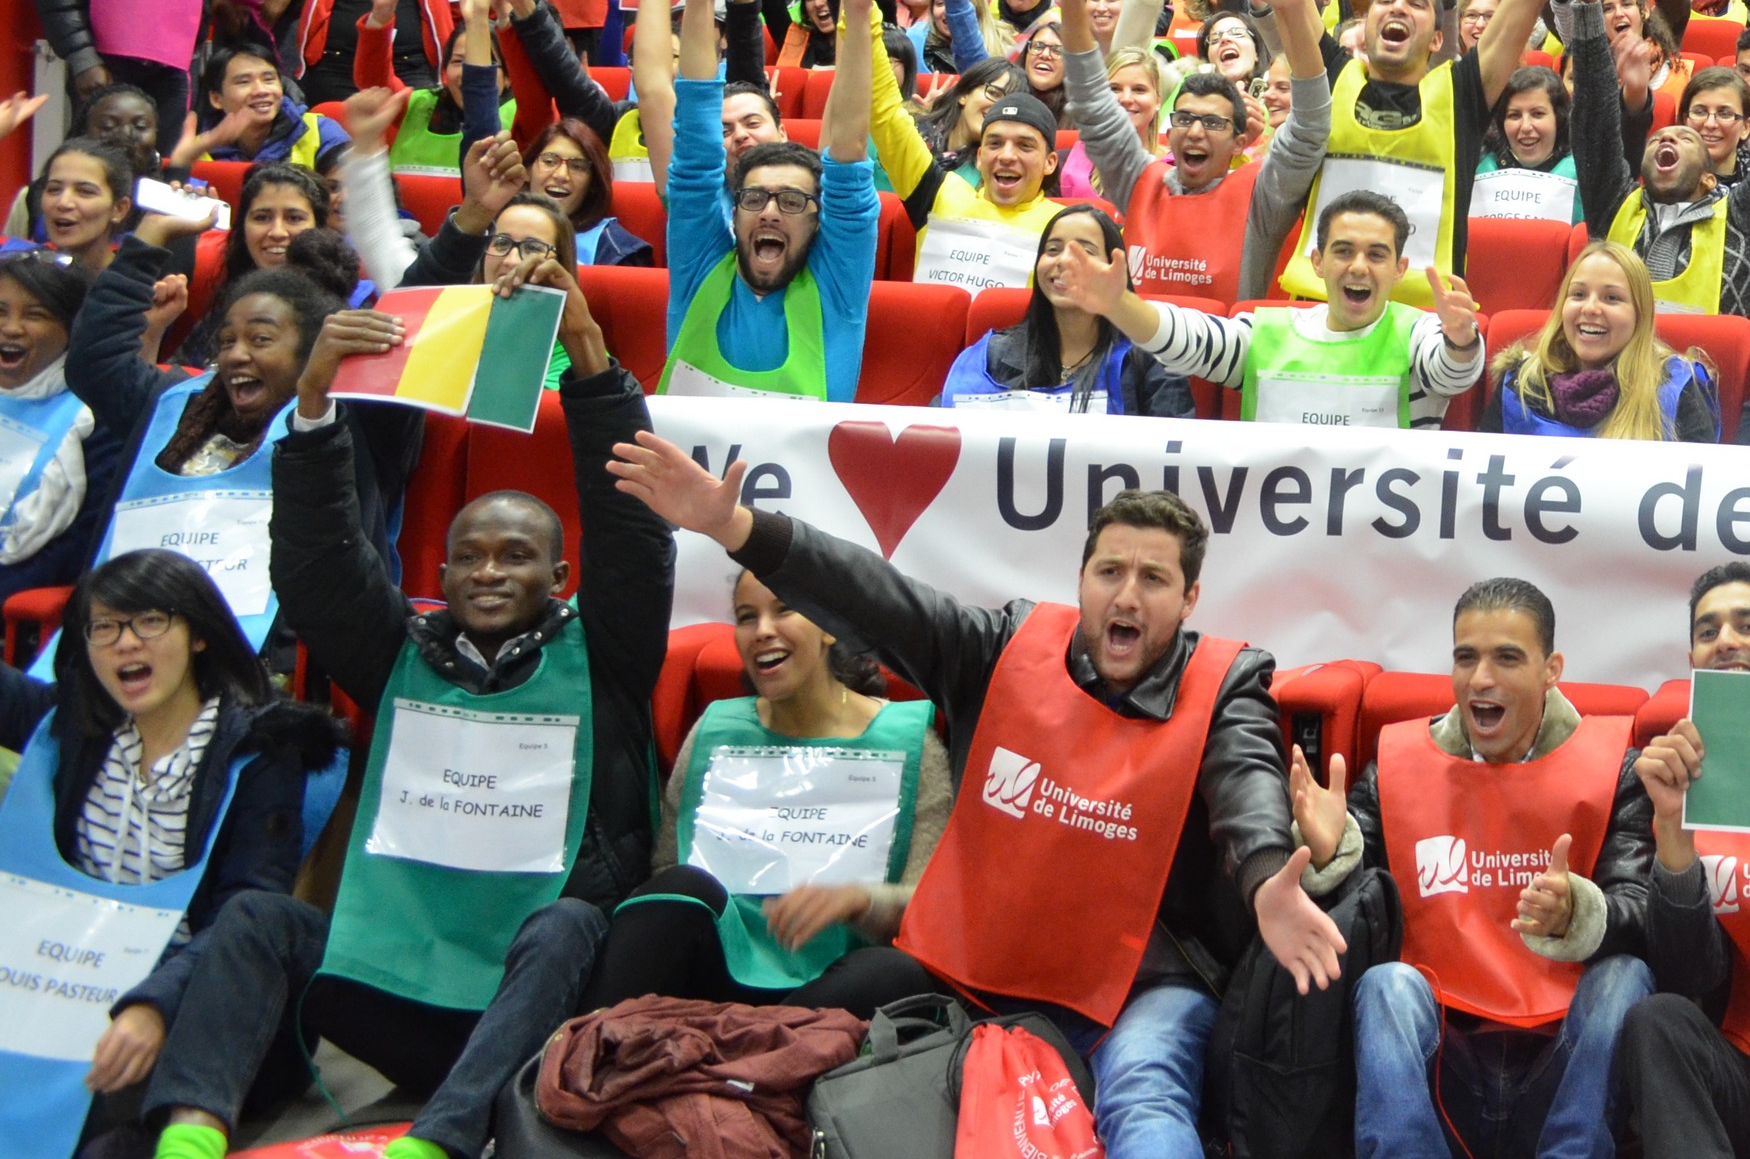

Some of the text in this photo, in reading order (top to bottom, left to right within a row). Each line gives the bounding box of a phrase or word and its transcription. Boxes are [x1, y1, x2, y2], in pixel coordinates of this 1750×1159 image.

[1494, 190, 1541, 204] EQUIPE
[950, 249, 991, 265] EQUIPE
[1146, 254, 1207, 271] Université
[929, 269, 965, 283] VICTOR
[1145, 268, 1213, 285] de Limoges
[1302, 412, 1350, 426] EQUIPE
[997, 437, 1582, 545] Université
[160, 532, 219, 547] EQUIPE
[443, 769, 497, 789] EQUIPE
[400, 790, 543, 818] J. de la FONTAINE
[1040, 778, 1133, 821] Université
[1033, 797, 1138, 841] de Limoges
[763, 830, 774, 842] la
[781, 831, 868, 848] FONTAINE
[1471, 849, 1552, 869] Universit
[1471, 870, 1492, 887] de
[37, 940, 106, 968] EQUIPE
[0, 966, 118, 1003] OUIS PASTEUR
